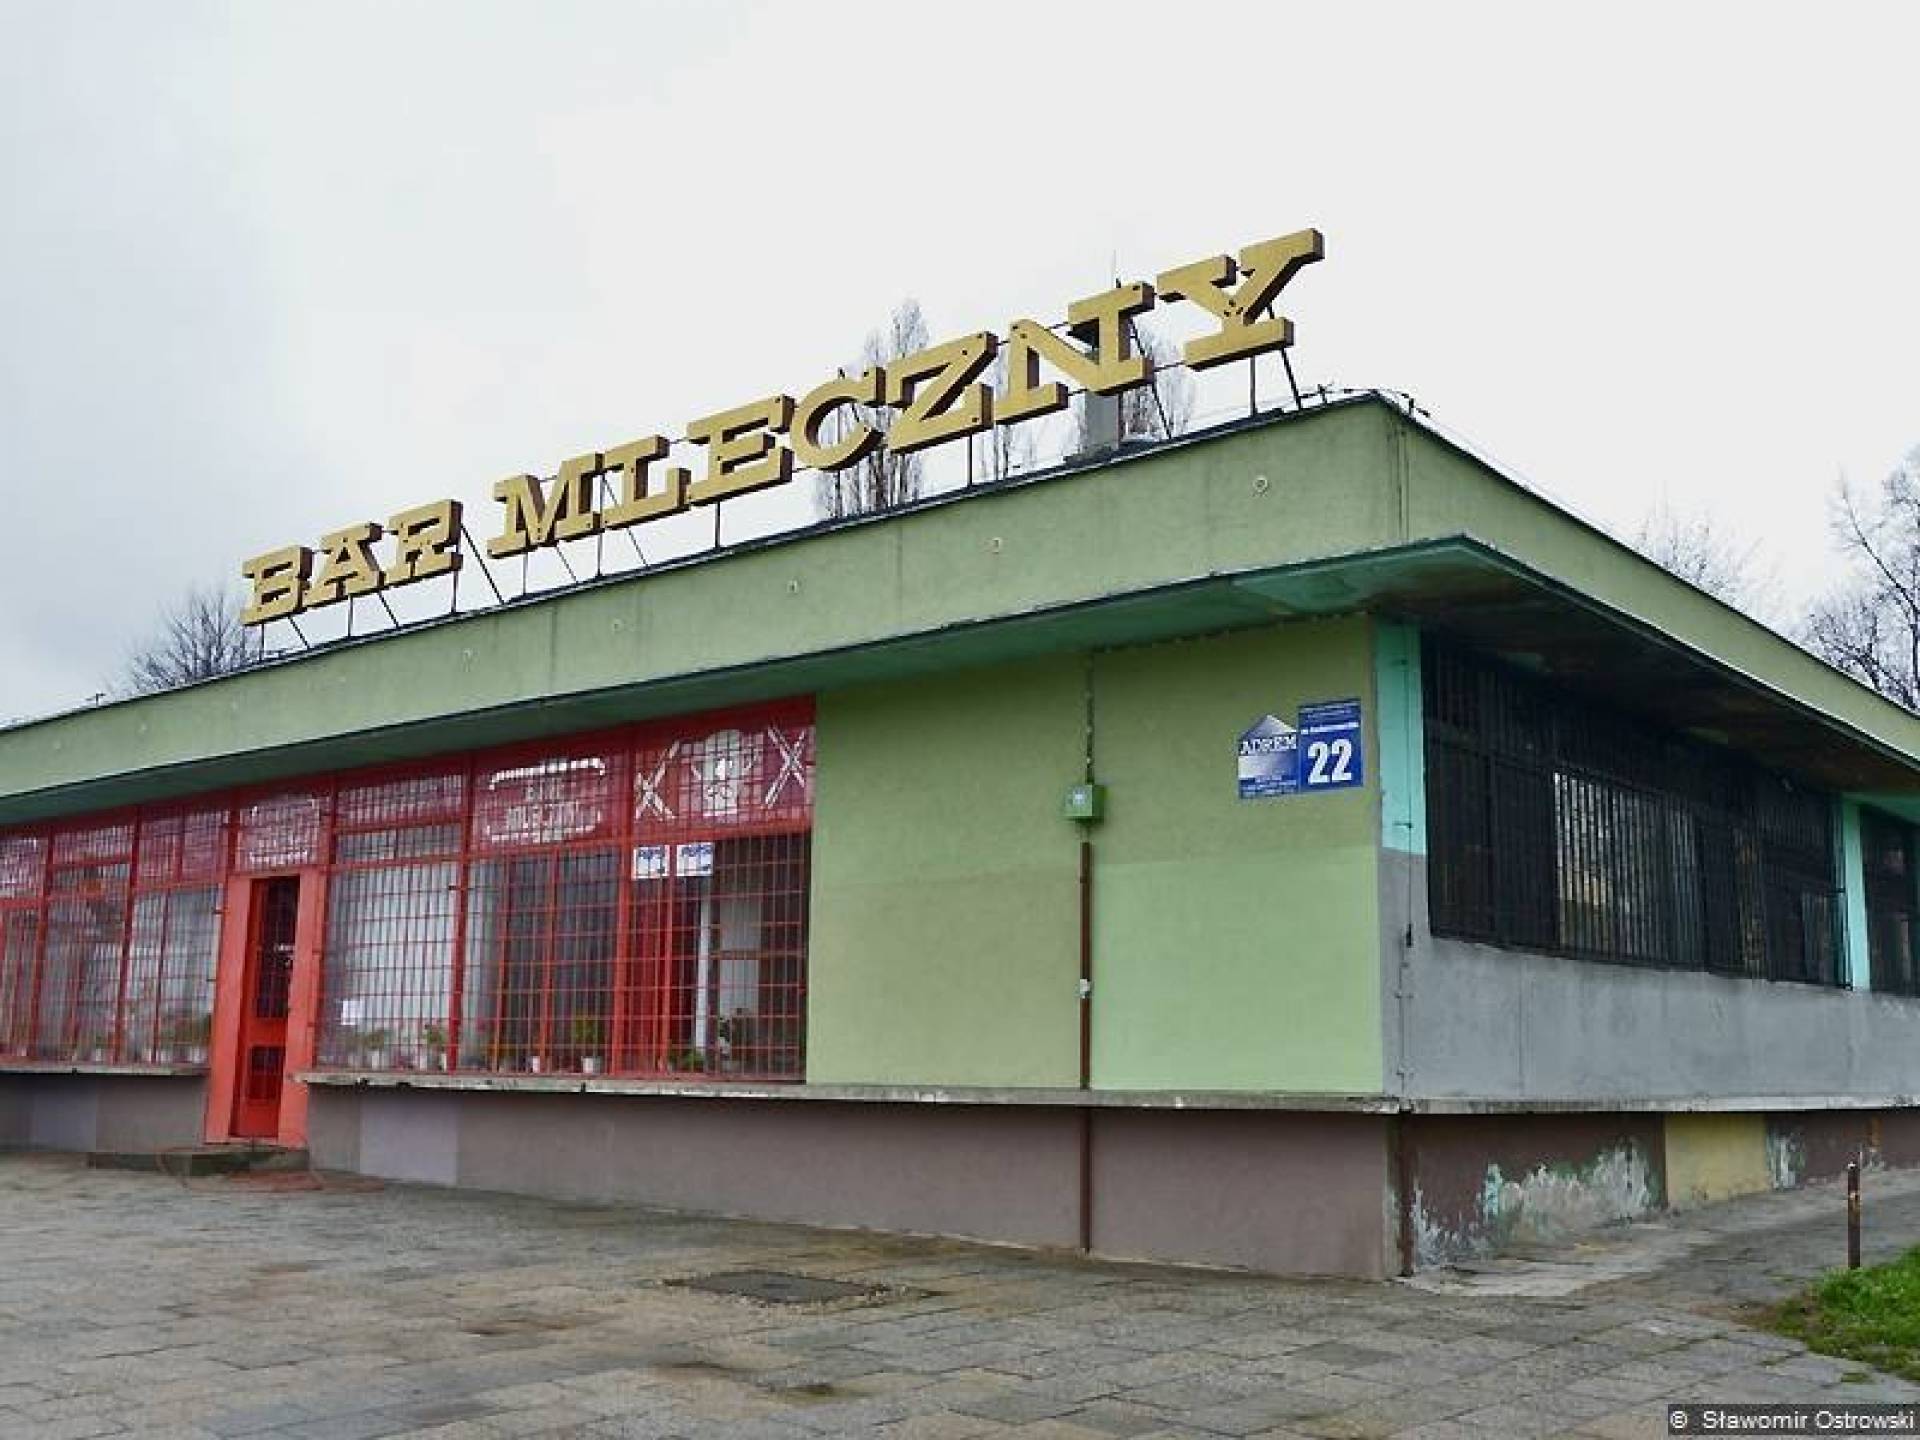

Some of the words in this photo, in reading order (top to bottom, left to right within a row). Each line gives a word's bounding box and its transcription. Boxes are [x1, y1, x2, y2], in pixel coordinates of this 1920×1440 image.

[240, 499, 463, 626] BAR
[487, 229, 1325, 559] MLECZNY
[1307, 738, 1352, 785] 22
